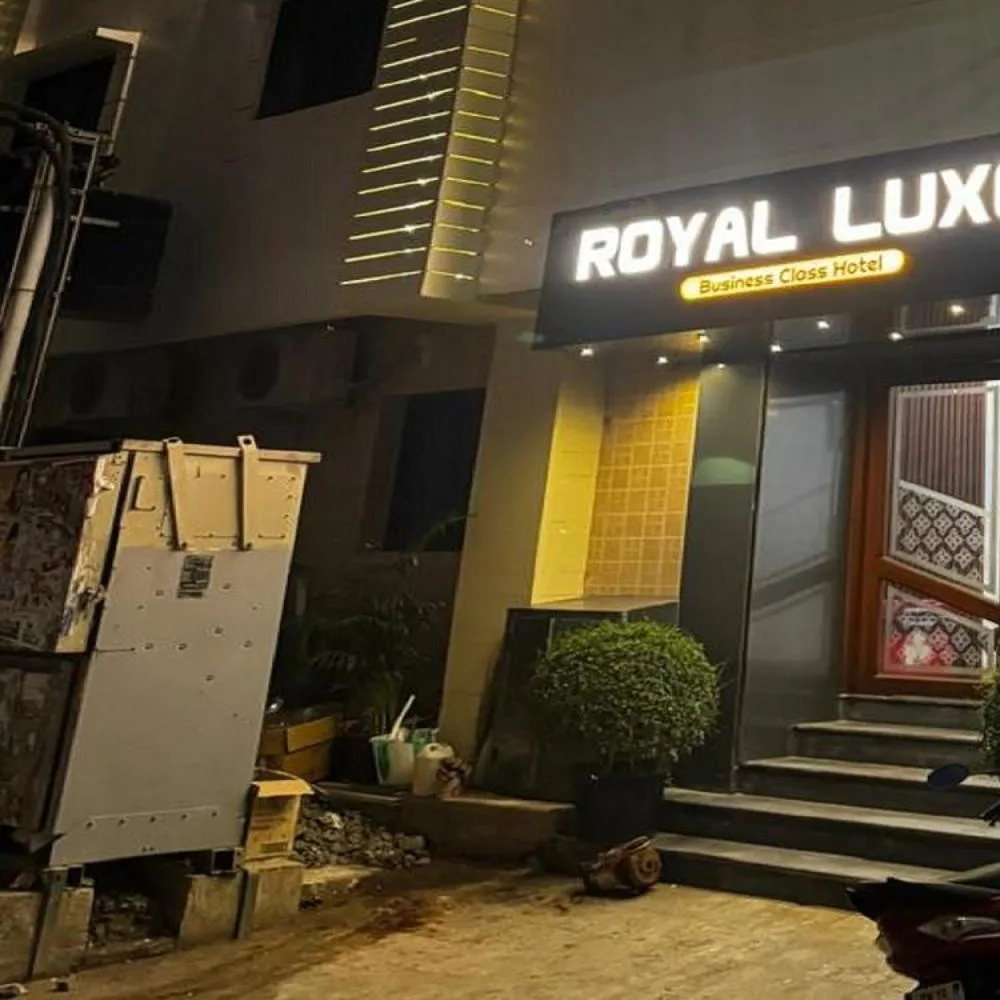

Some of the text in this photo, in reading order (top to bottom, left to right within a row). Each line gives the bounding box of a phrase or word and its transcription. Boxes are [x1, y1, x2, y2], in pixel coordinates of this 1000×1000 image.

[574, 200, 798, 281] ROYAL
[699, 255, 884, 294] Business Class Hotel
